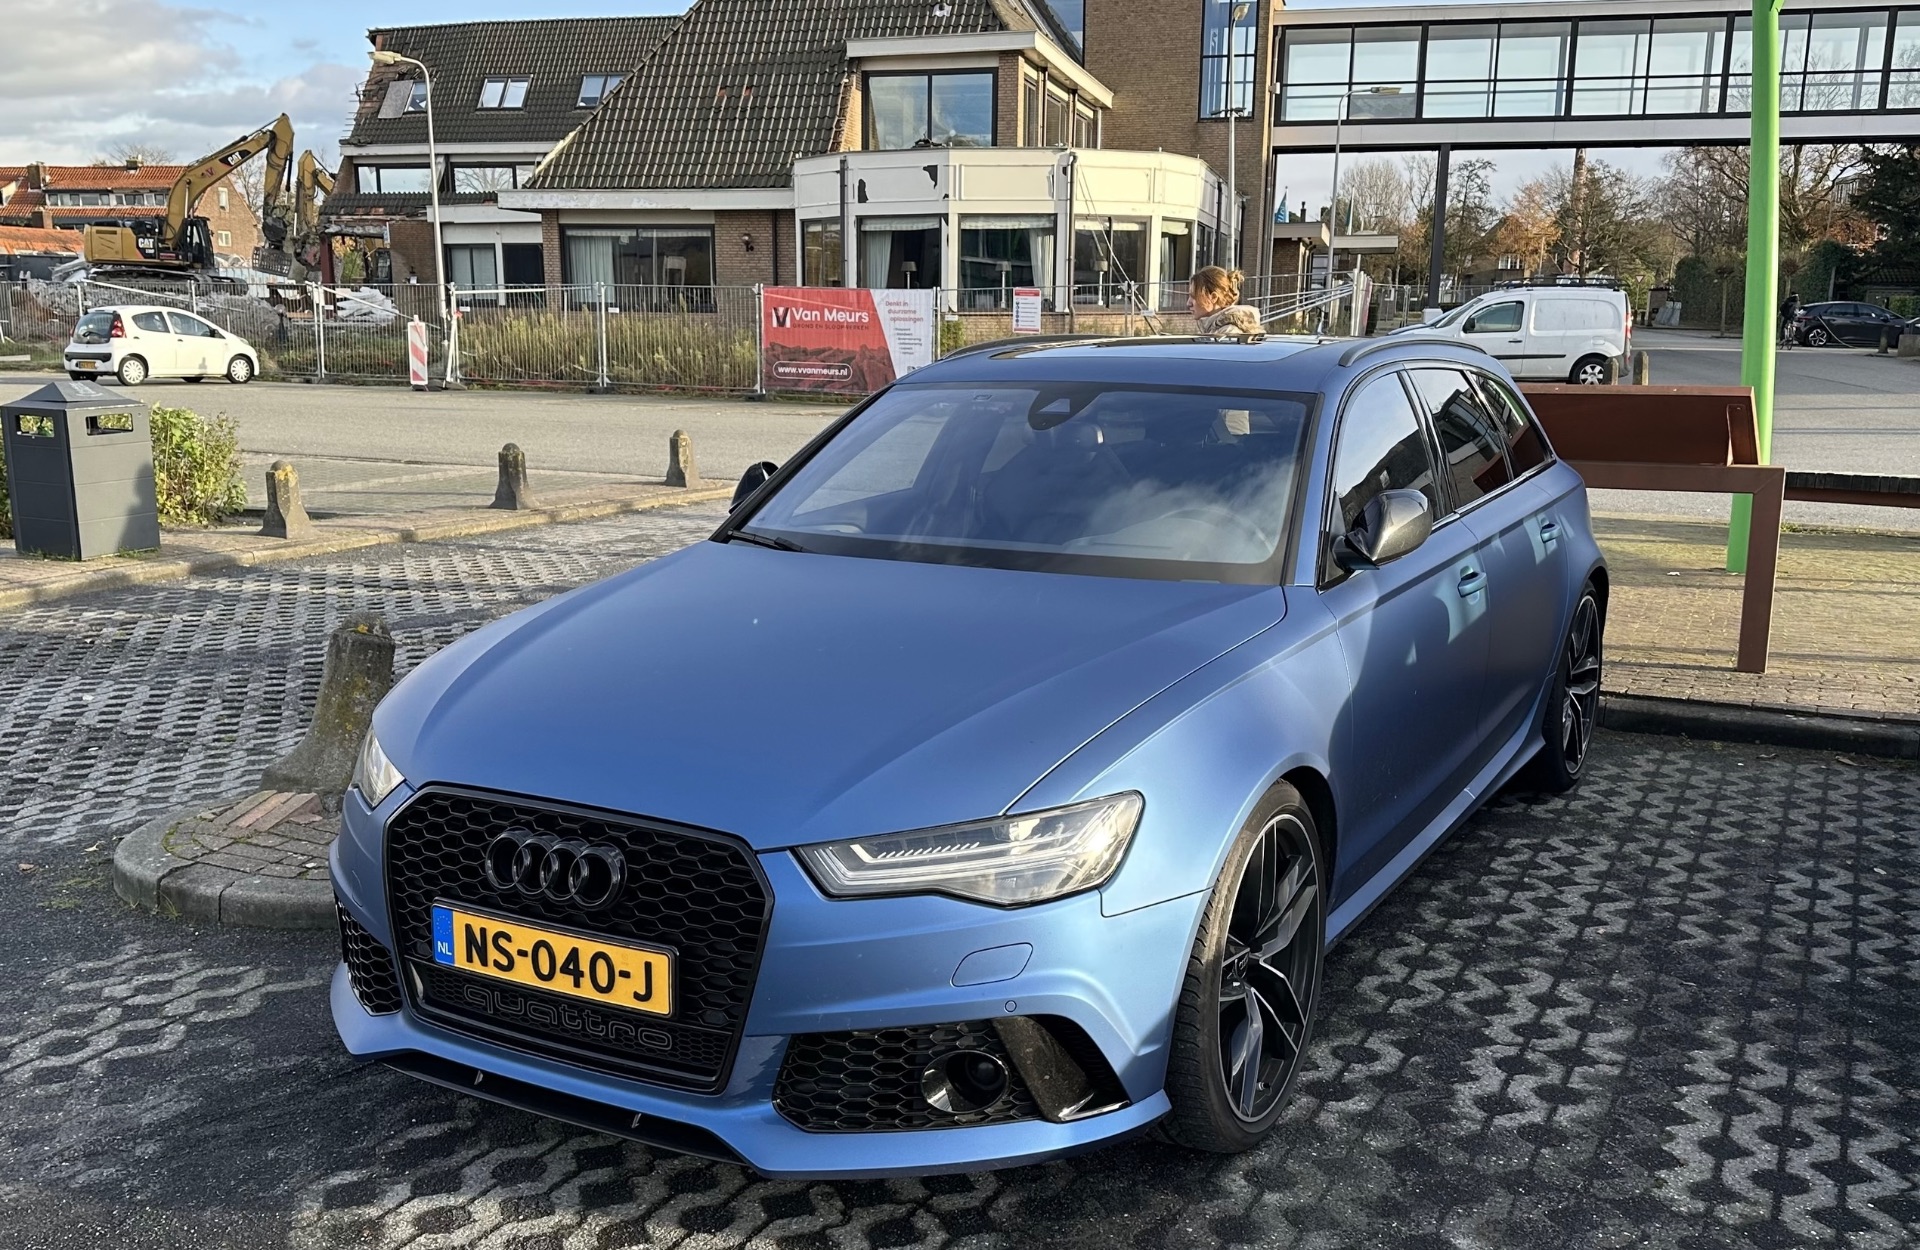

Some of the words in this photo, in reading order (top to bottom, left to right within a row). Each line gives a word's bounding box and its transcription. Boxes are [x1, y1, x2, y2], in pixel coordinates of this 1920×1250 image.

[228, 151, 242, 165] CAT
[138, 238, 154, 248] CAT
[792, 307, 820, 321] Van
[824, 308, 869, 323] Meurs
[778, 366, 848, 376] www.vvanmeurs.nl
[437, 941, 452, 956] NL
[464, 923, 653, 1002] NS-040-J
[464, 984, 673, 1050] quattro
